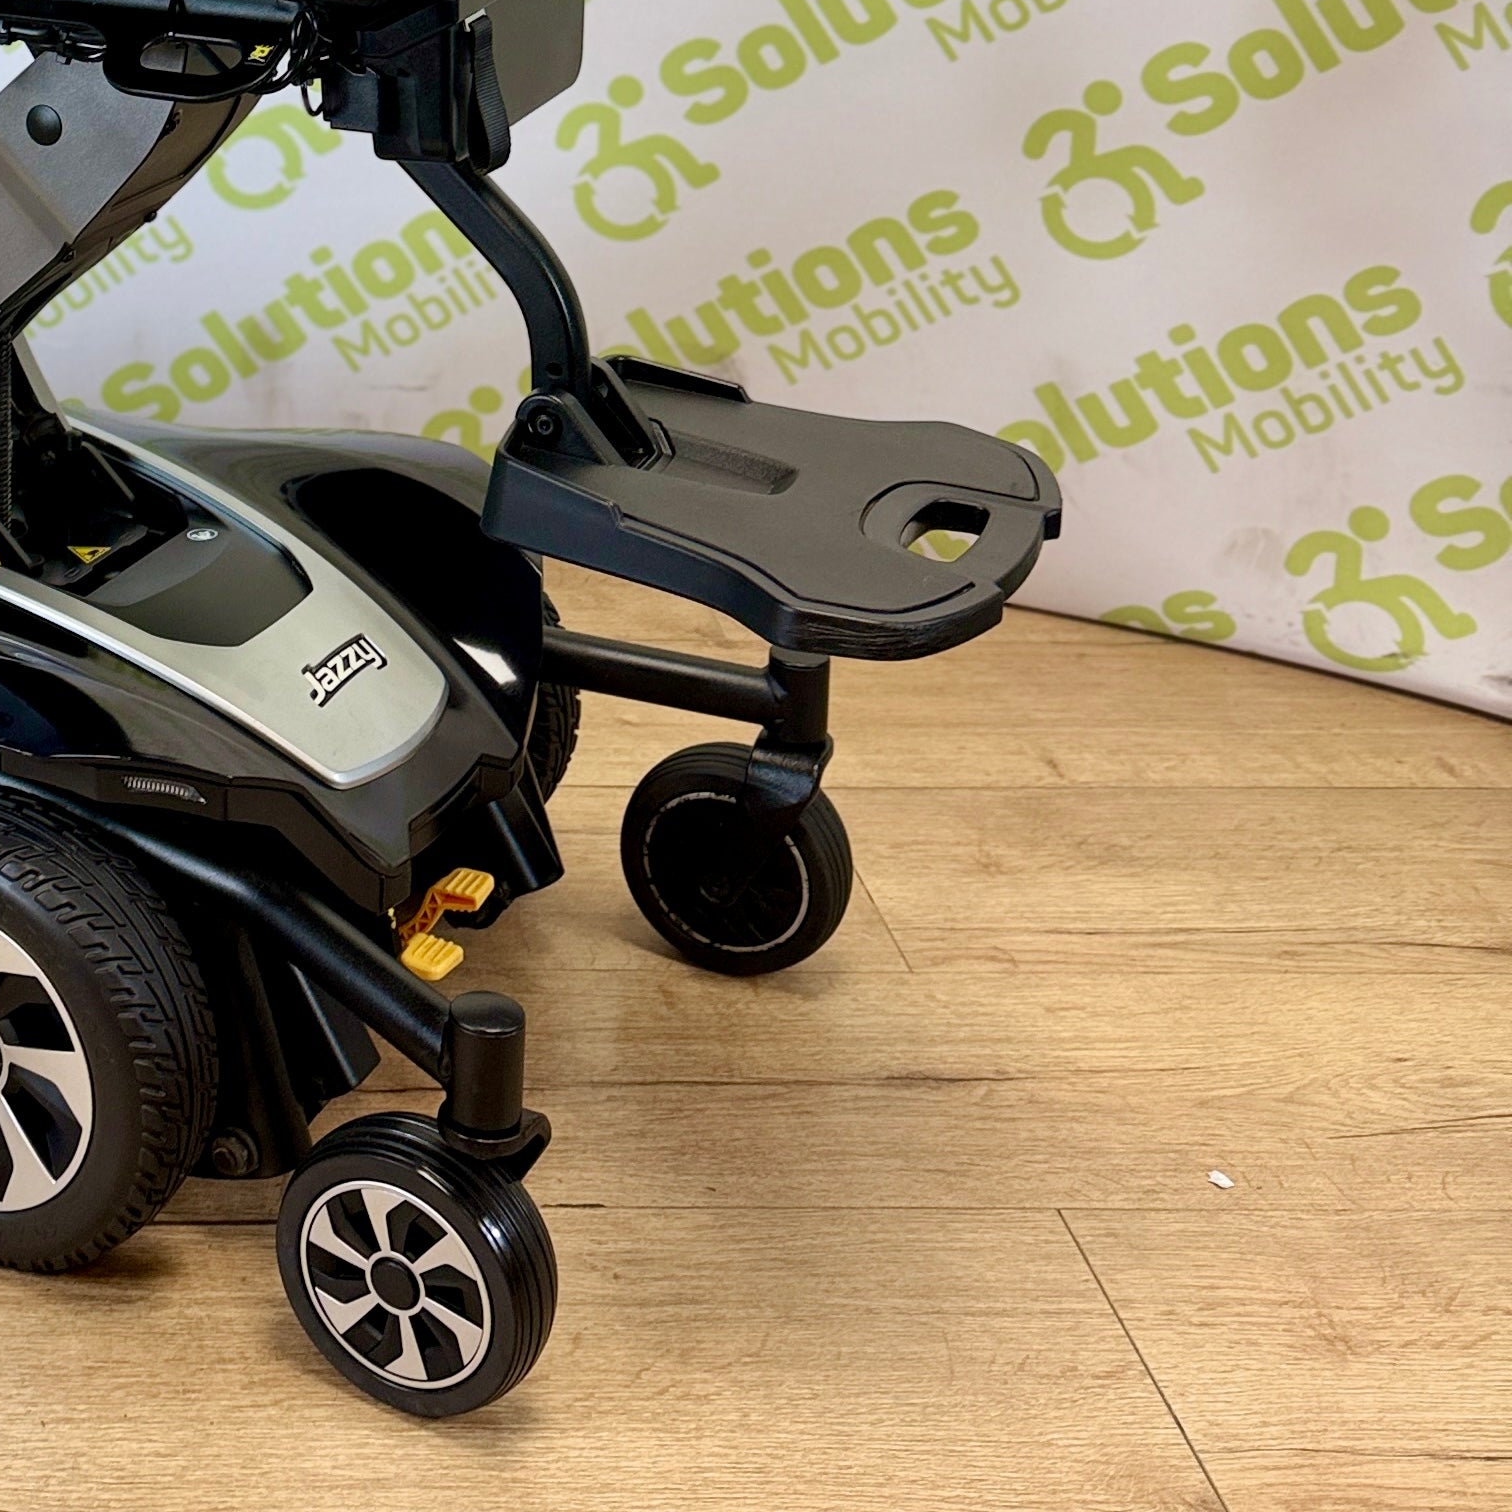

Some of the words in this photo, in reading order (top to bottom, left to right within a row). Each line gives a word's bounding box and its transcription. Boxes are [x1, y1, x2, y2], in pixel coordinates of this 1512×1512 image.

[100, 209, 474, 425] Solution
[598, 189, 979, 367] lutions
[766, 255, 1020, 385] Mobility
[994, 264, 1423, 475] olutions
[1186, 336, 1465, 475] Mobility
[302, 636, 385, 706] Jazzy
